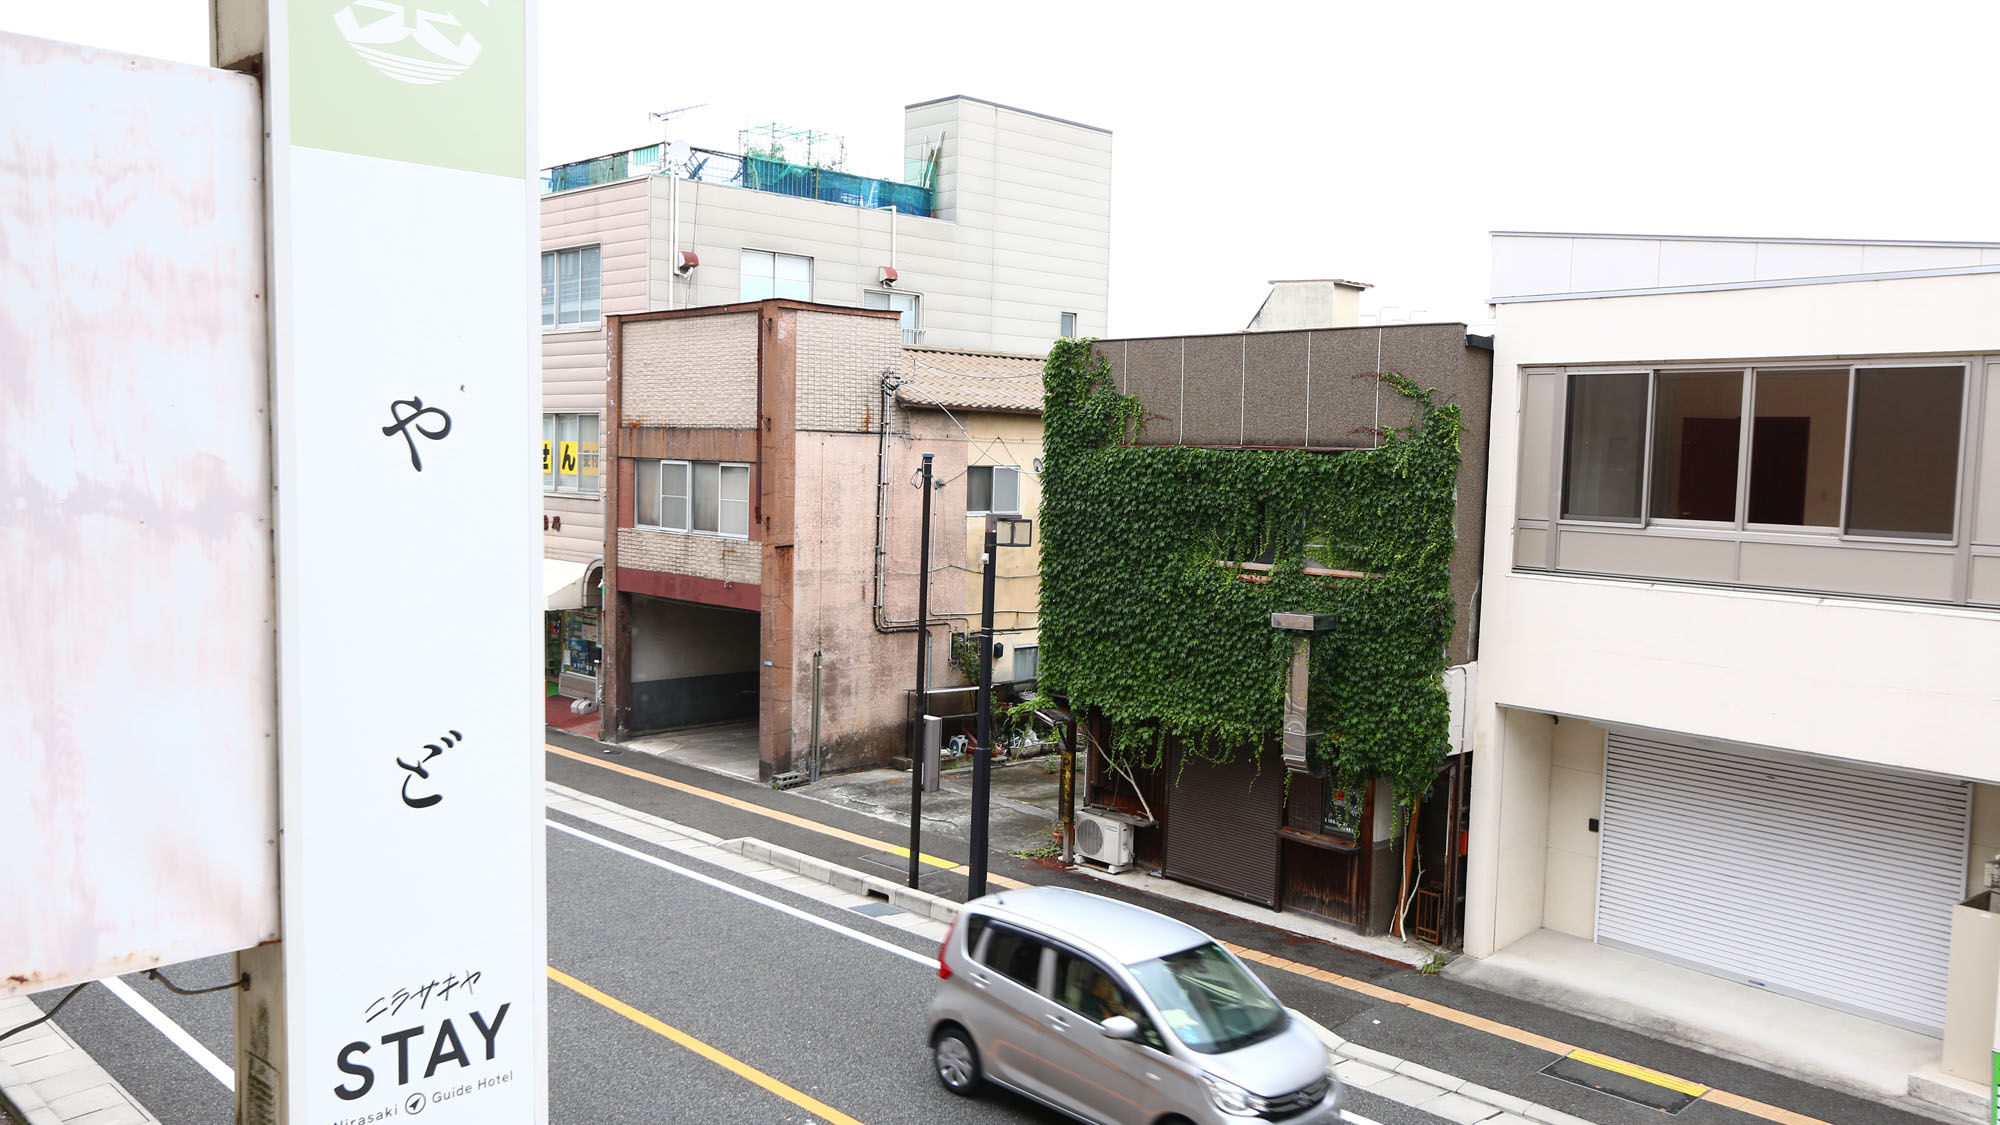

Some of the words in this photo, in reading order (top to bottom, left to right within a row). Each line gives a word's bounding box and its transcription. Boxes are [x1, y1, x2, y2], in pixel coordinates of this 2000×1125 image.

[365, 970, 481, 1023] ニラサキヤ
[334, 1002, 511, 1101] STAY
[432, 1084, 473, 1103] Guide
[478, 1070, 513, 1090] Hotel
